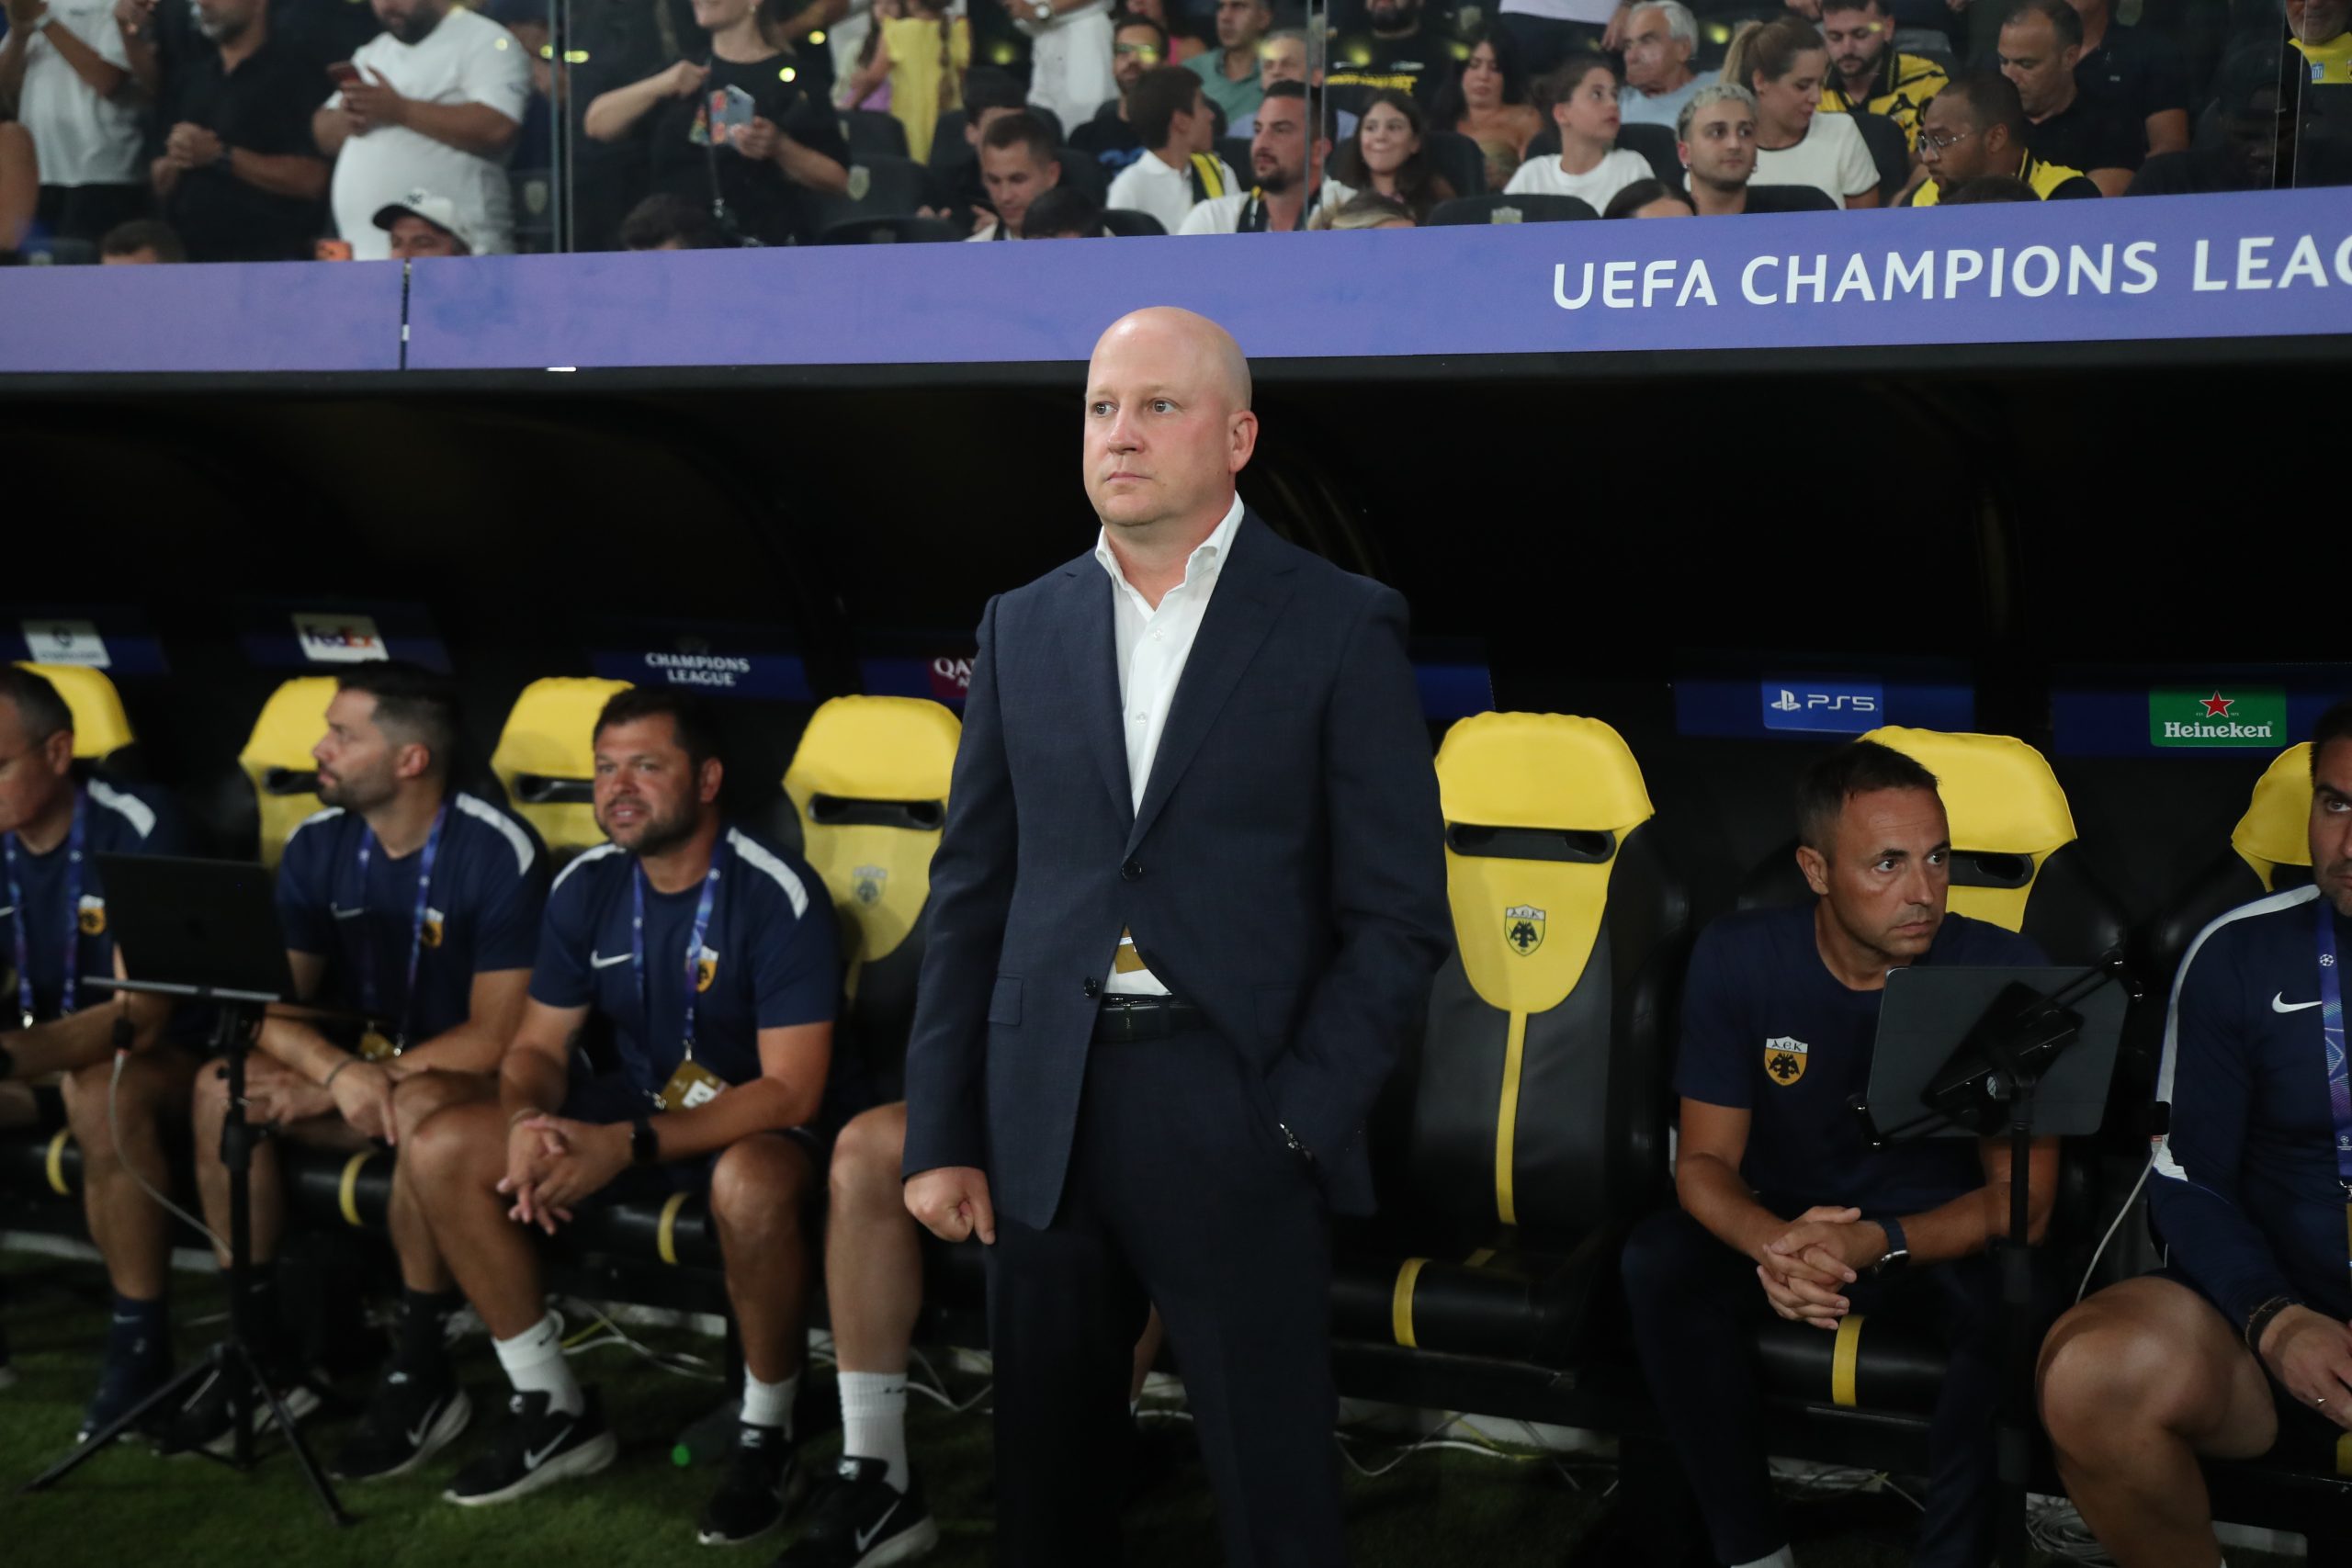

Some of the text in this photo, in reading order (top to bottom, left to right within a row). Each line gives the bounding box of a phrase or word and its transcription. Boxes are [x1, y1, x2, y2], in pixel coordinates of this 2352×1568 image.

[1554, 259, 1717, 310] UEFA
[1742, 242, 2157, 305] CHAMPIONS
[645, 652, 751, 673] CHAMPIONS
[666, 669, 736, 687] LEAGUE
[1808, 695, 1874, 710] PS5
[2164, 721, 2272, 738] Heineken
